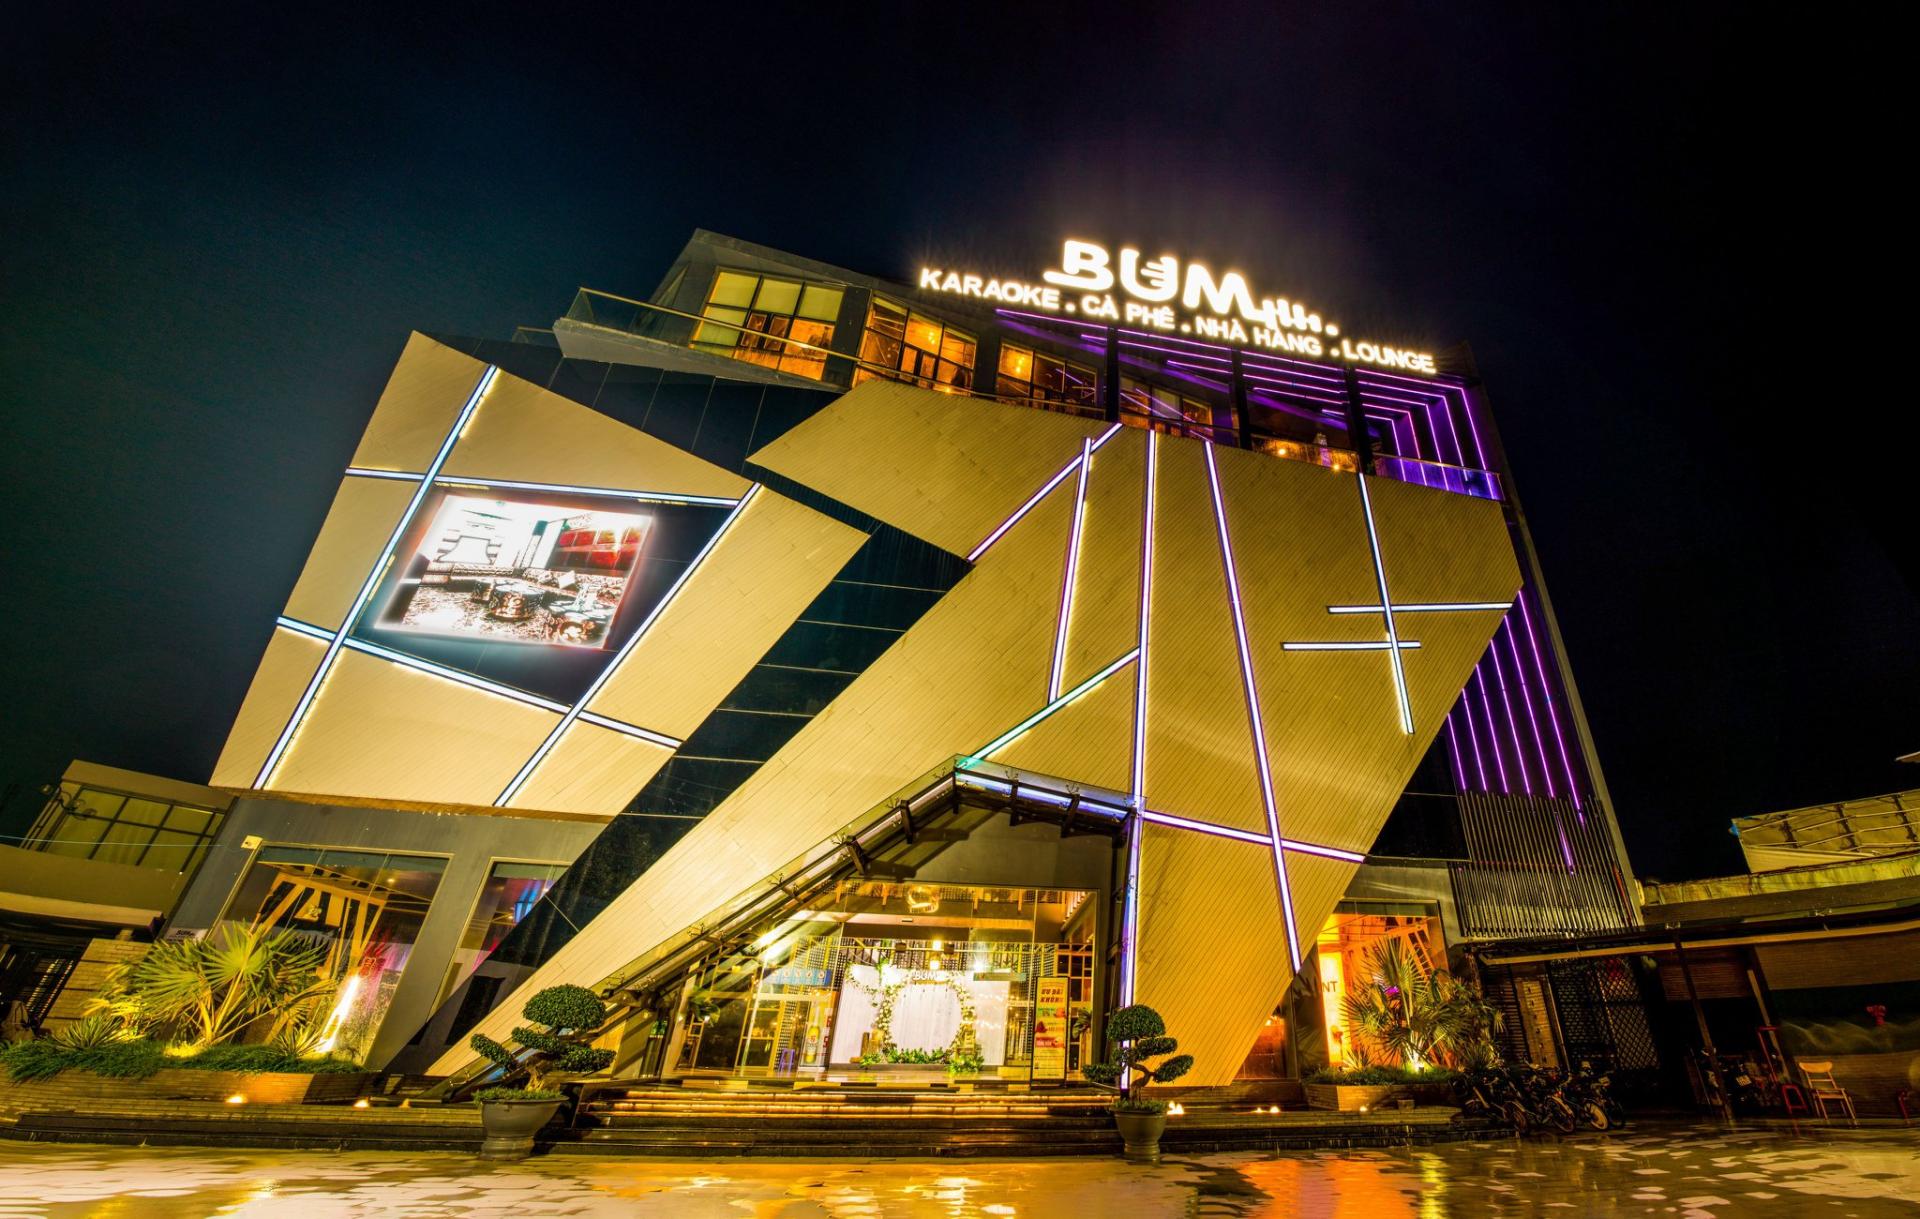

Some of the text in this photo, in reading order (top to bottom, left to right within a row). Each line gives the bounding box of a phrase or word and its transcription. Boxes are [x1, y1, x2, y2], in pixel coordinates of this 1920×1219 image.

[919, 267, 1437, 375] KARAOKE CÀ PHÊ NHÀ HÀNG LOUNGE
